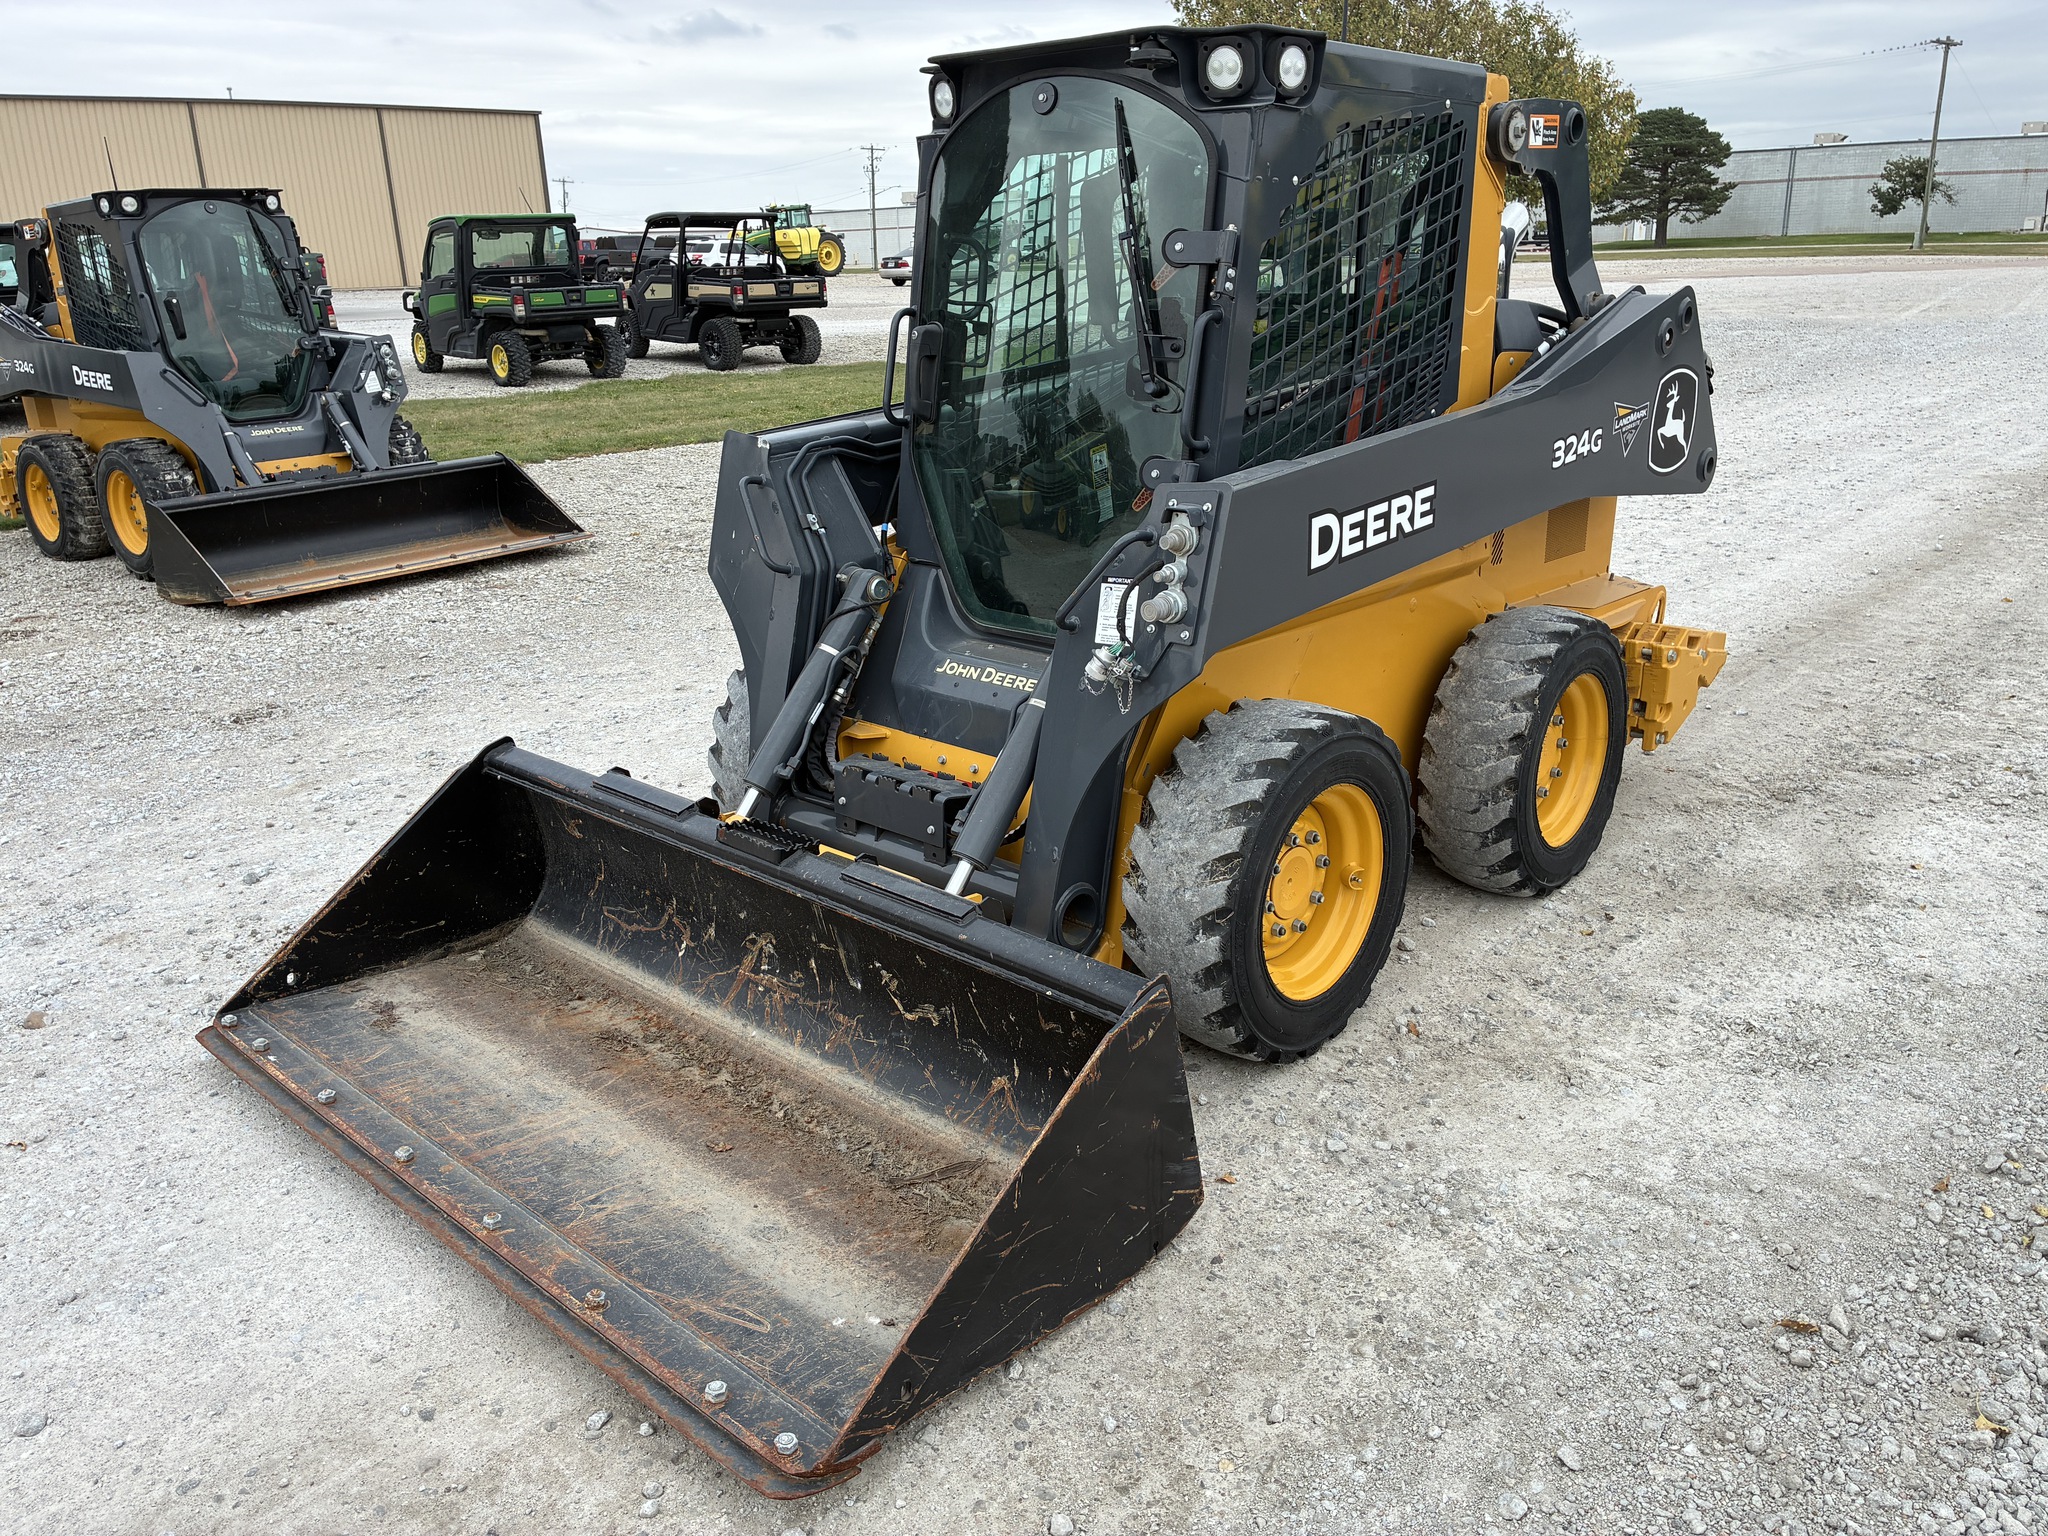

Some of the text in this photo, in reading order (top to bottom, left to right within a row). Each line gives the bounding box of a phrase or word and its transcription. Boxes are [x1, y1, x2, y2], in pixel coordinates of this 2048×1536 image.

[13, 359, 35, 375] 324G
[71, 364, 114, 392] DEERE
[250, 425, 305, 437] JOHN DEERE
[1551, 428, 1603, 469] 324G
[1310, 484, 1435, 570] DEERE
[935, 658, 1039, 692] JOHN DEERE
